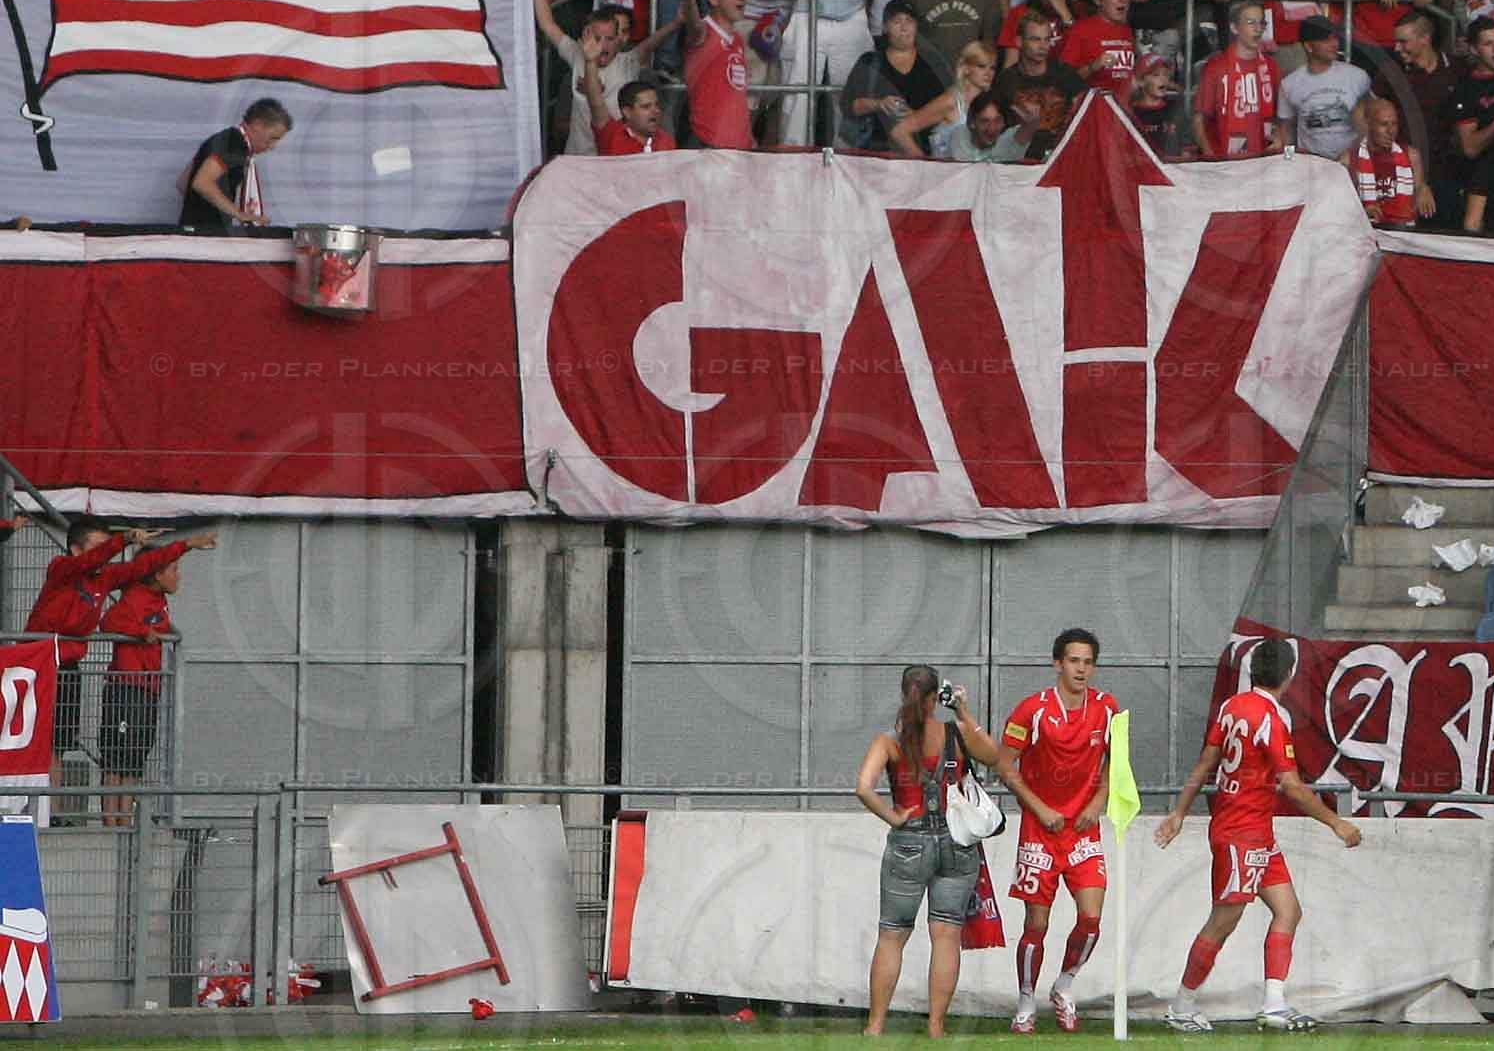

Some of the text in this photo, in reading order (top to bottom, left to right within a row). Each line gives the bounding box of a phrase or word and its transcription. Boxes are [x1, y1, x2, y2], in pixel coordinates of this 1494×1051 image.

[546, 89, 1305, 511] GAK
[1221, 713, 1249, 774] 26
[1017, 863, 1041, 895] 25
